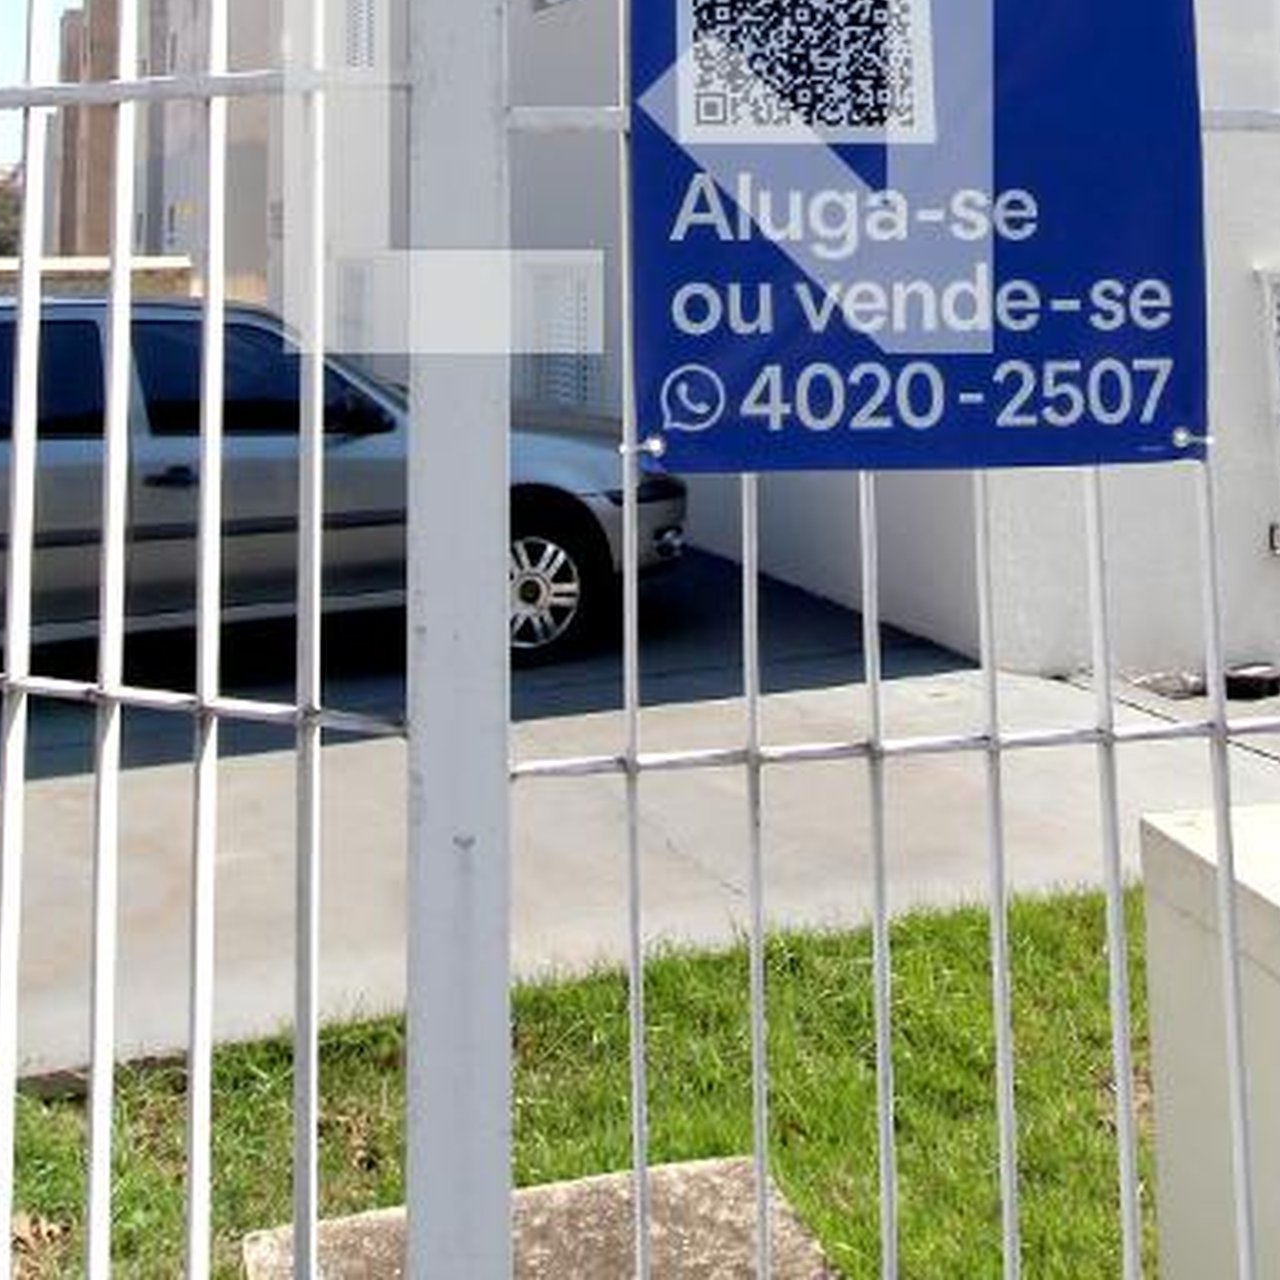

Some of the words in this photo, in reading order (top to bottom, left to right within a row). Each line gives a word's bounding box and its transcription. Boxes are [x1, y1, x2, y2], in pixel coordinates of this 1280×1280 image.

[669, 173, 1039, 259] Aluga-se
[670, 281, 774, 335] ou
[797, 263, 1173, 332] vende-se
